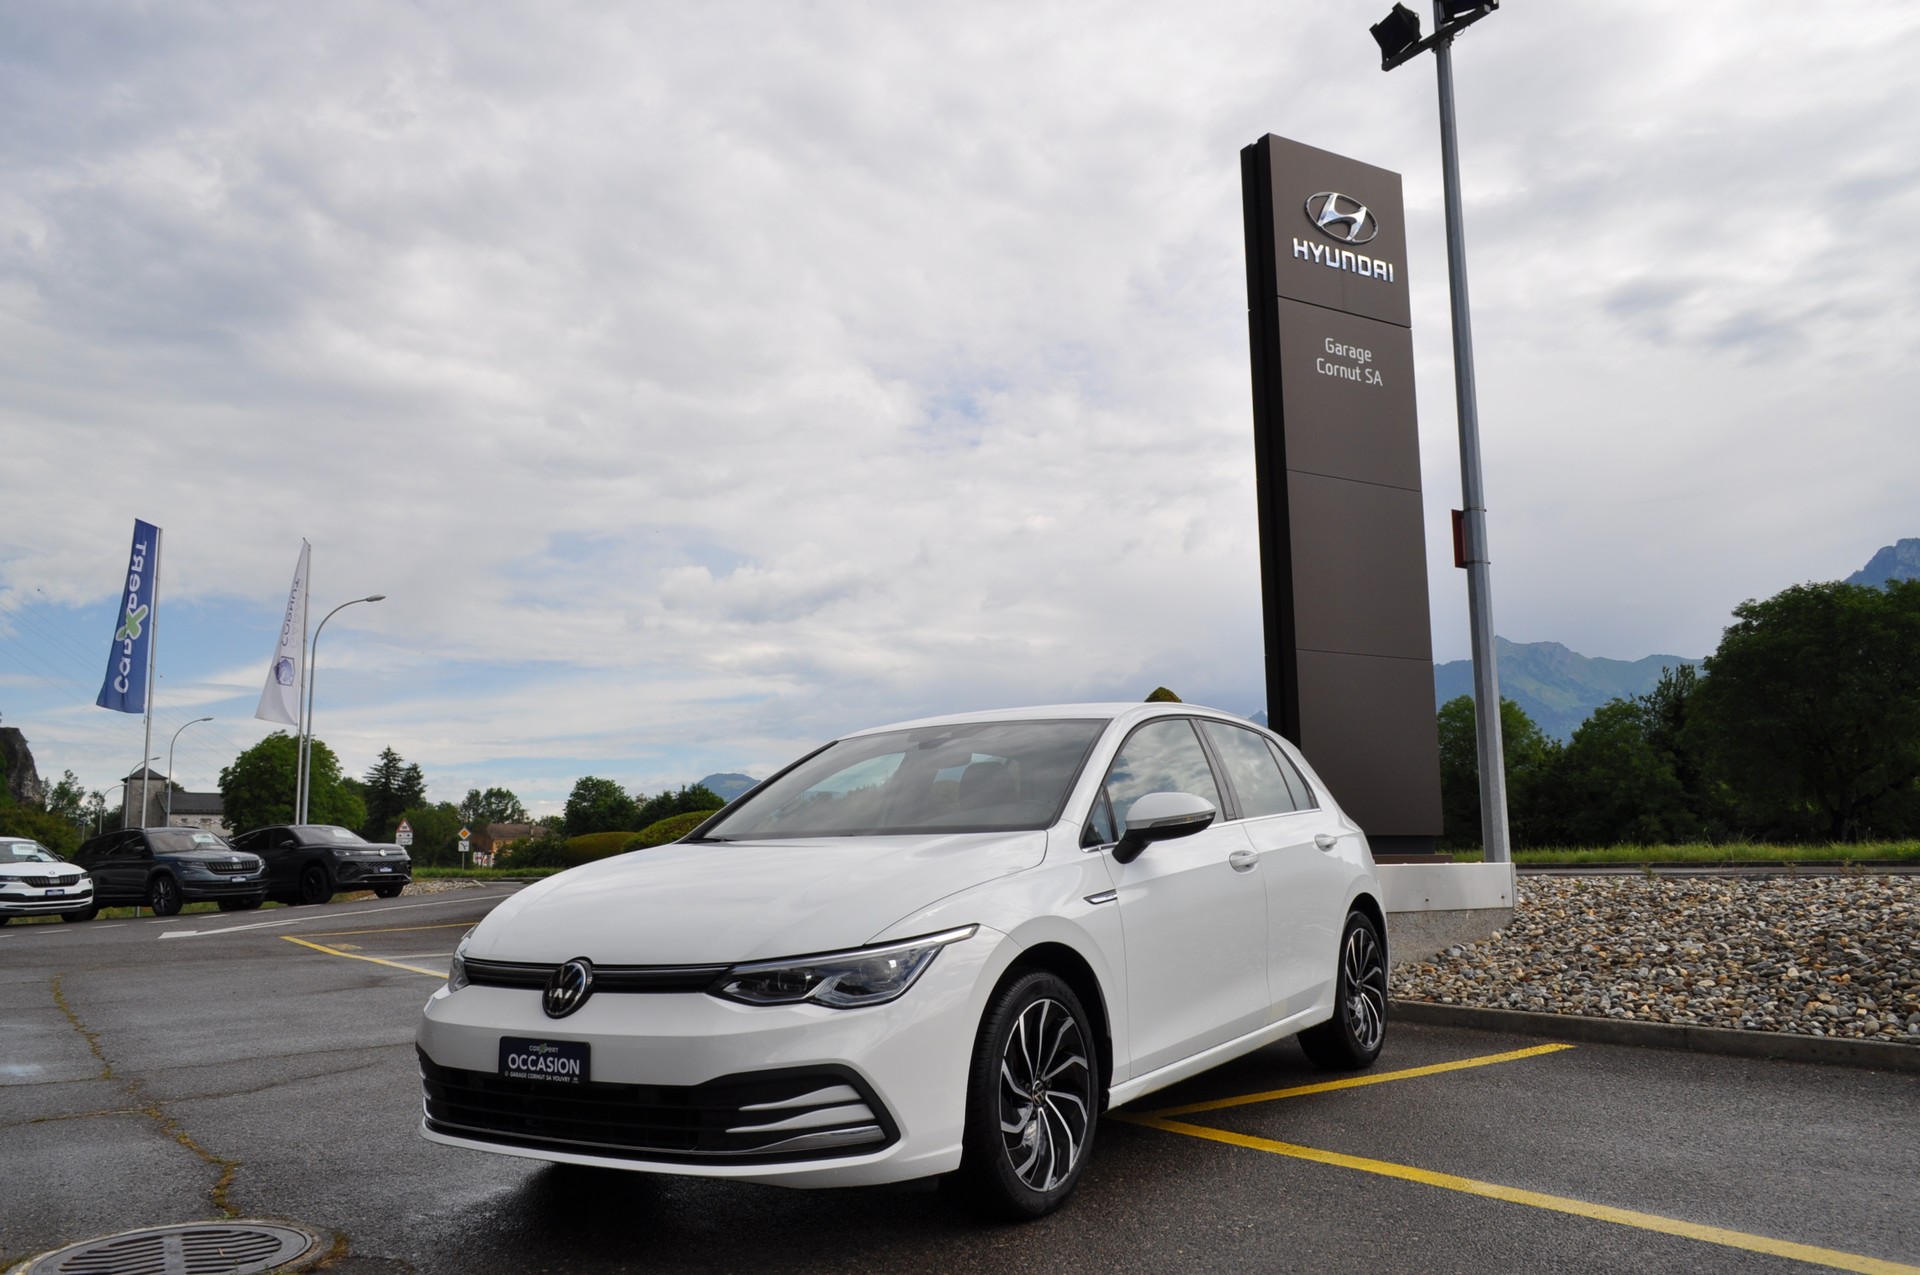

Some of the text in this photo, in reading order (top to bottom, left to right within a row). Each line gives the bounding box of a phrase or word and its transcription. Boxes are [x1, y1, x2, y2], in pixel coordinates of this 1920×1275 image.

[1293, 237, 1394, 283] HYUNDAI
[1325, 337, 1372, 364] Garage
[1316, 357, 1383, 386] Cornut SA
[508, 1053, 580, 1075] OCCASION
[509, 1071, 527, 1079] GARAGE
[527, 1072, 545, 1081] CORNUT
